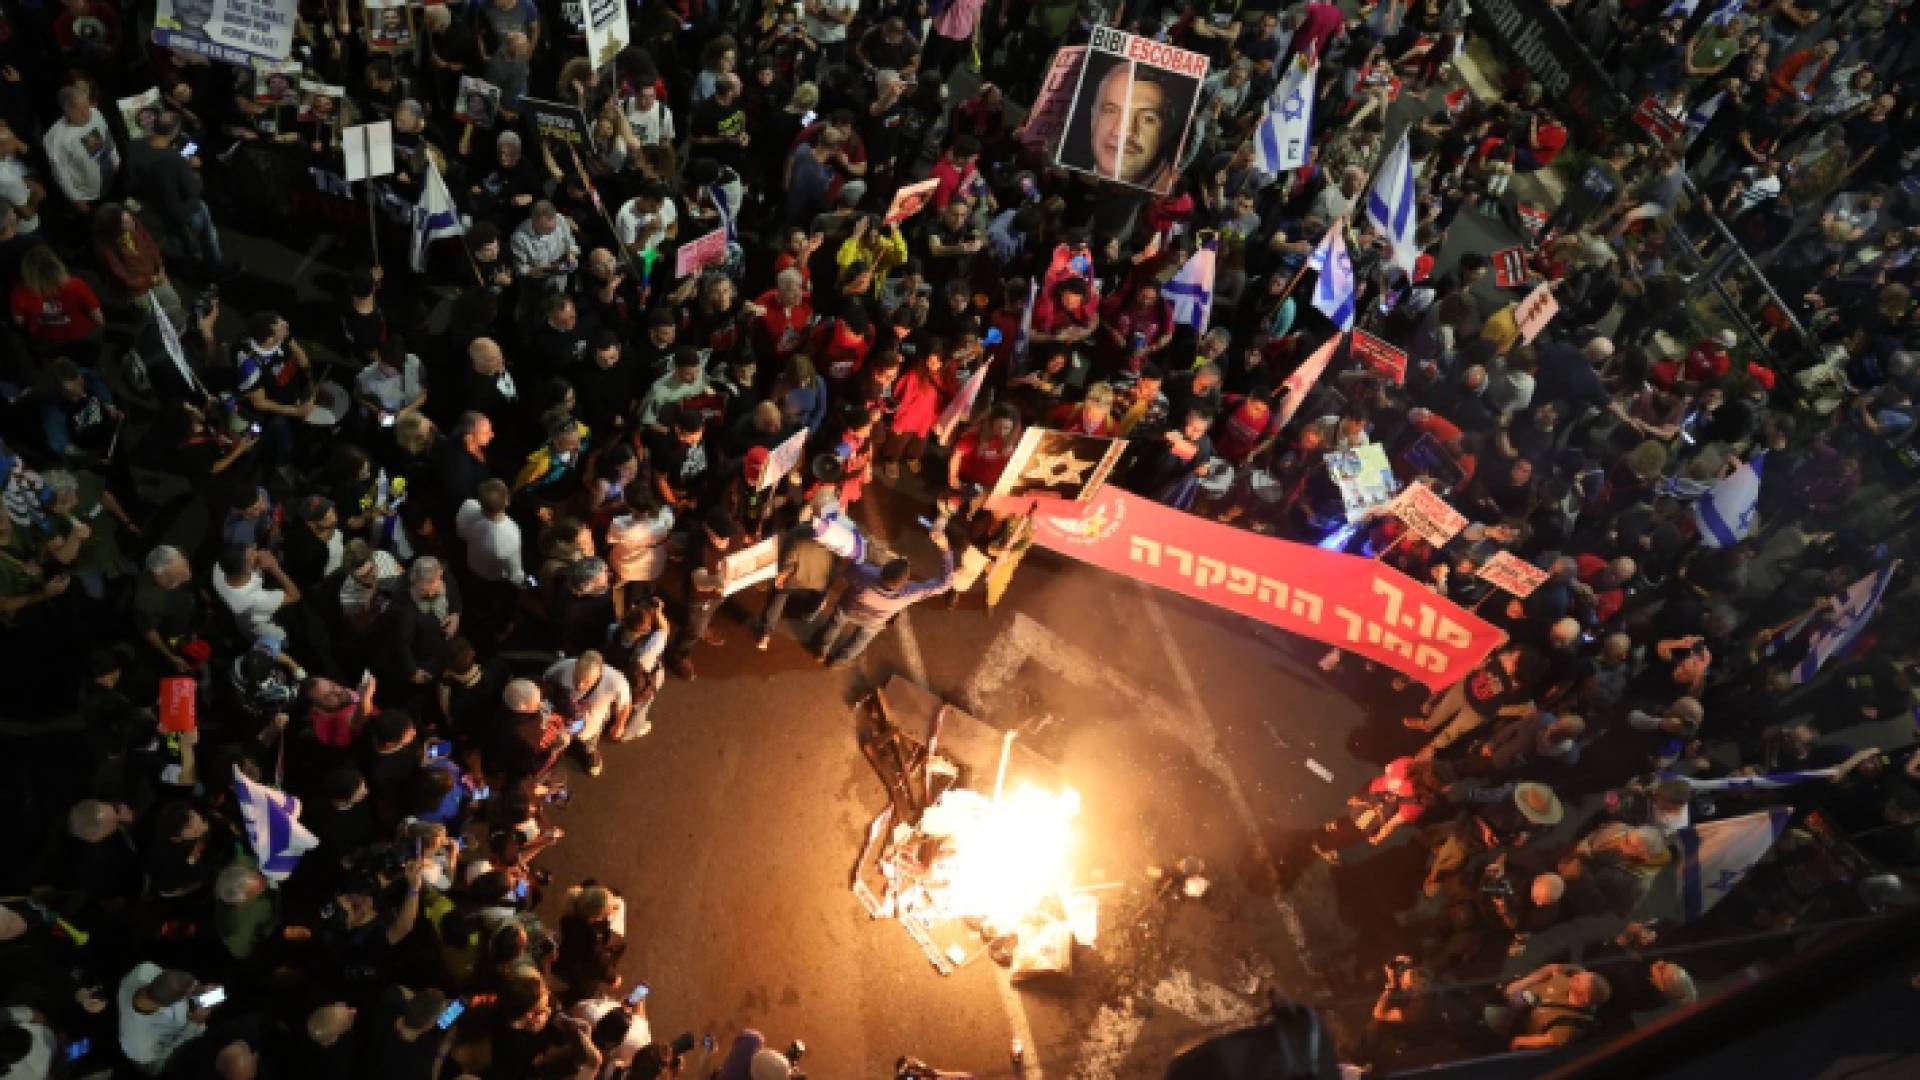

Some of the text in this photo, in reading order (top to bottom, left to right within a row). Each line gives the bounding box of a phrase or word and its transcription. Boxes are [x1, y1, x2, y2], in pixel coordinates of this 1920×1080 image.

[1093, 28, 1205, 76] BIBI ESCOBAR
[1513, 18, 1570, 98] Home
[1129, 535, 1449, 674] מחיר ההפקרה
